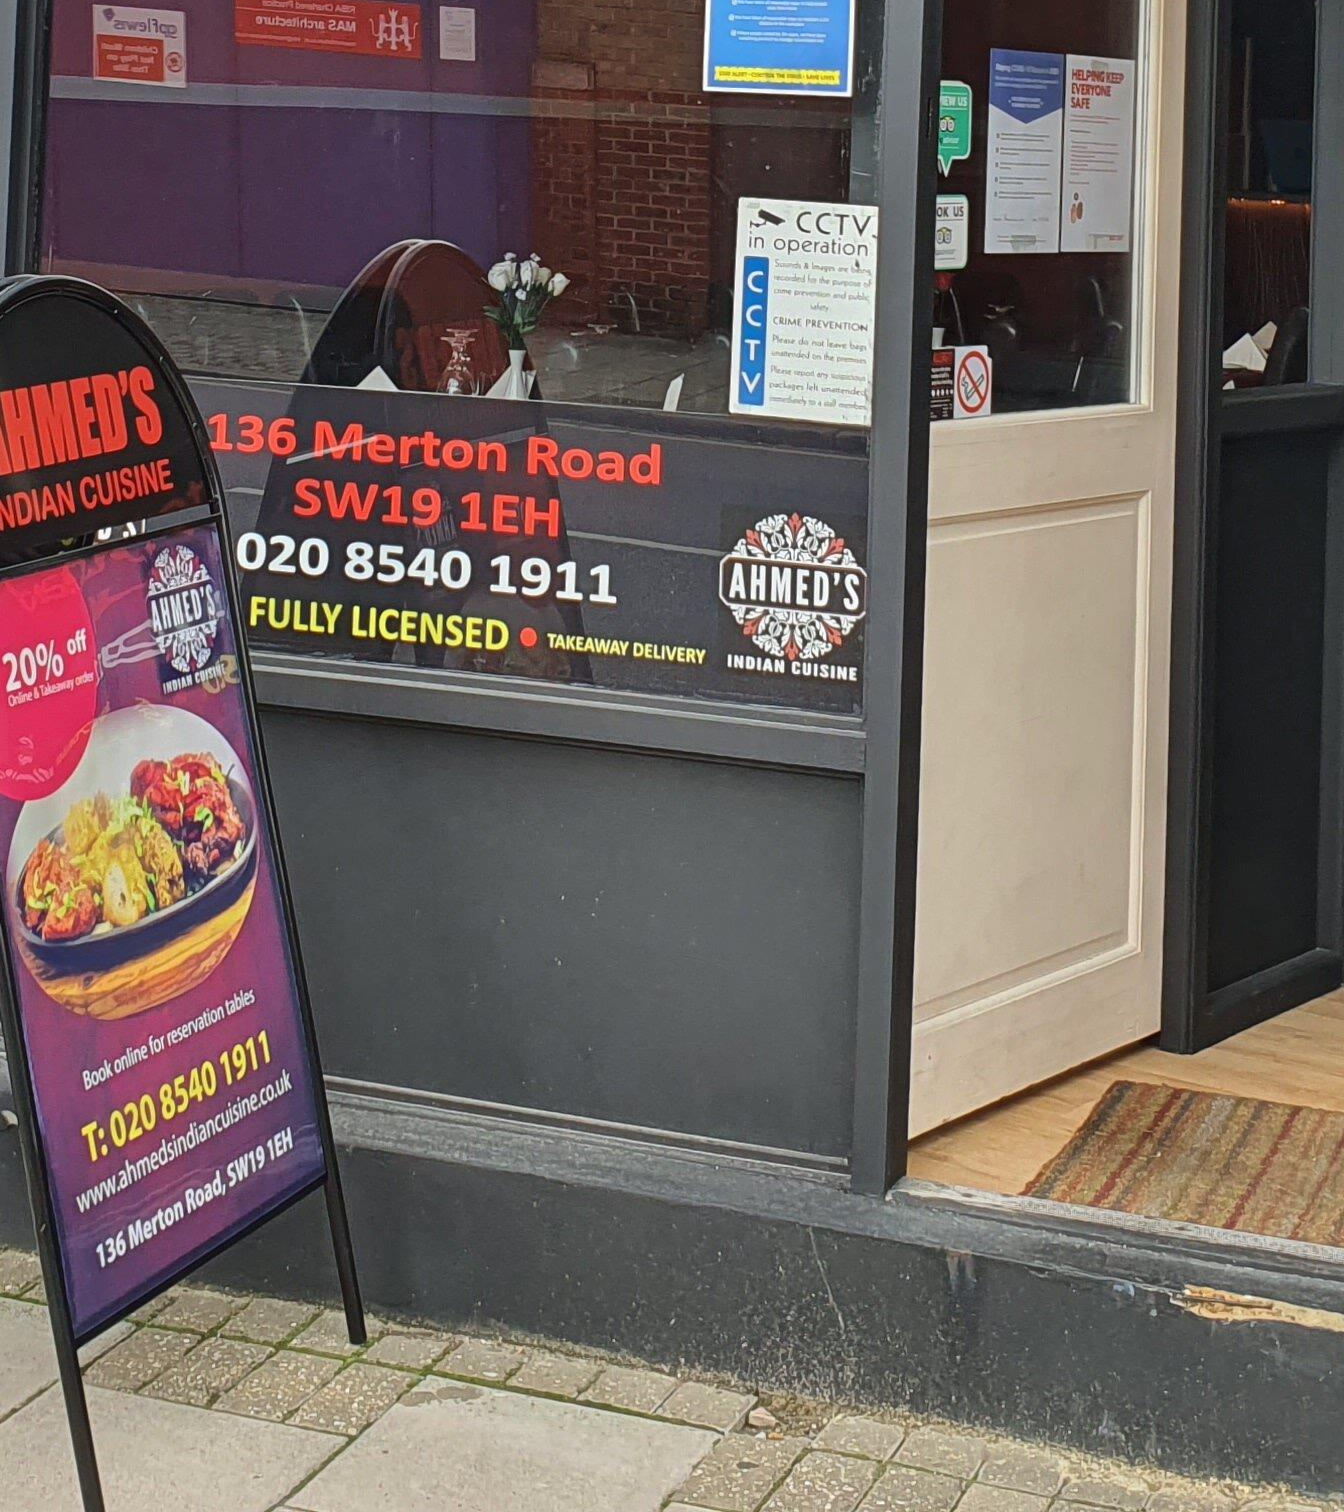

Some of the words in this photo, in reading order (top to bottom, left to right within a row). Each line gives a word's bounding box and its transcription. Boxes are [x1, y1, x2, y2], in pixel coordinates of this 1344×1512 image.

[1071, 69, 1105, 83] HELPING
[1105, 71, 1125, 85] KEEP
[1071, 83, 1111, 97] EVERYONE
[957, 96, 968, 107] US
[1071, 97, 1091, 109] SAFE
[796, 211, 871, 236] CCTV
[953, 206, 964, 218] US
[748, 231, 764, 248] in
[774, 237, 868, 256] operation
[773, 274, 805, 283] recorded
[818, 275, 830, 285] the
[832, 278, 861, 288] purpose
[794, 289, 831, 299] prevention
[833, 291, 846, 300] and
[741, 270, 764, 394] CCTV
[773, 316, 802, 327] CRIME
[805, 318, 868, 332] PREVENTION
[771, 350, 810, 360] unattended
[772, 334, 796, 345] Please
[798, 337, 809, 346] do
[811, 338, 824, 347] not
[827, 339, 847, 348] leave
[769, 381, 804, 392] packages
[770, 364, 792, 376] Please
[207, 412, 297, 456] 136
[313, 420, 508, 473] Merton
[526, 434, 662, 485] Road
[78, 458, 175, 508] CUISINE
[293, 477, 443, 527] SW19
[460, 491, 560, 538] 1EH
[236, 532, 330, 577] 020
[343, 541, 472, 589] 8540
[490, 554, 618, 605] 1911
[728, 562, 861, 612] AHMED'S
[150, 583, 217, 633] AHMED'S
[249, 595, 343, 635] FULLY
[351, 604, 510, 652] LICENSED
[1, 639, 65, 694] 20%
[66, 627, 87, 656] off
[546, 632, 631, 657] TAKEAWAY
[632, 641, 707, 666] DELIVERY
[162, 674, 193, 695] INDIAN
[194, 662, 226, 685] CUISINE
[726, 653, 786, 675] INDIAN
[791, 658, 858, 682] CUISINE
[7, 690, 33, 707] Online
[33, 686, 40, 700] &
[39, 678, 75, 697] Takeaway
[74, 671, 95, 687] order
[82, 1059, 114, 1091] Book
[113, 1045, 149, 1074] online
[147, 1034, 167, 1056] for
[166, 1005, 226, 1047] reservation
[225, 988, 256, 1016] tables
[81, 1120, 109, 1163] T:
[109, 1093, 157, 1148] 020
[158, 1059, 218, 1121] 8540
[219, 1029, 272, 1086] 1911
[75, 1068, 293, 1214] www.ahmedsindiancuisine.co.uk
[95, 1230, 127, 1269] 136
[126, 1199, 185, 1251] Merton
[184, 1169, 227, 1214] Road,
[226, 1144, 266, 1189] SW19
[266, 1125, 295, 1162] 1EH
